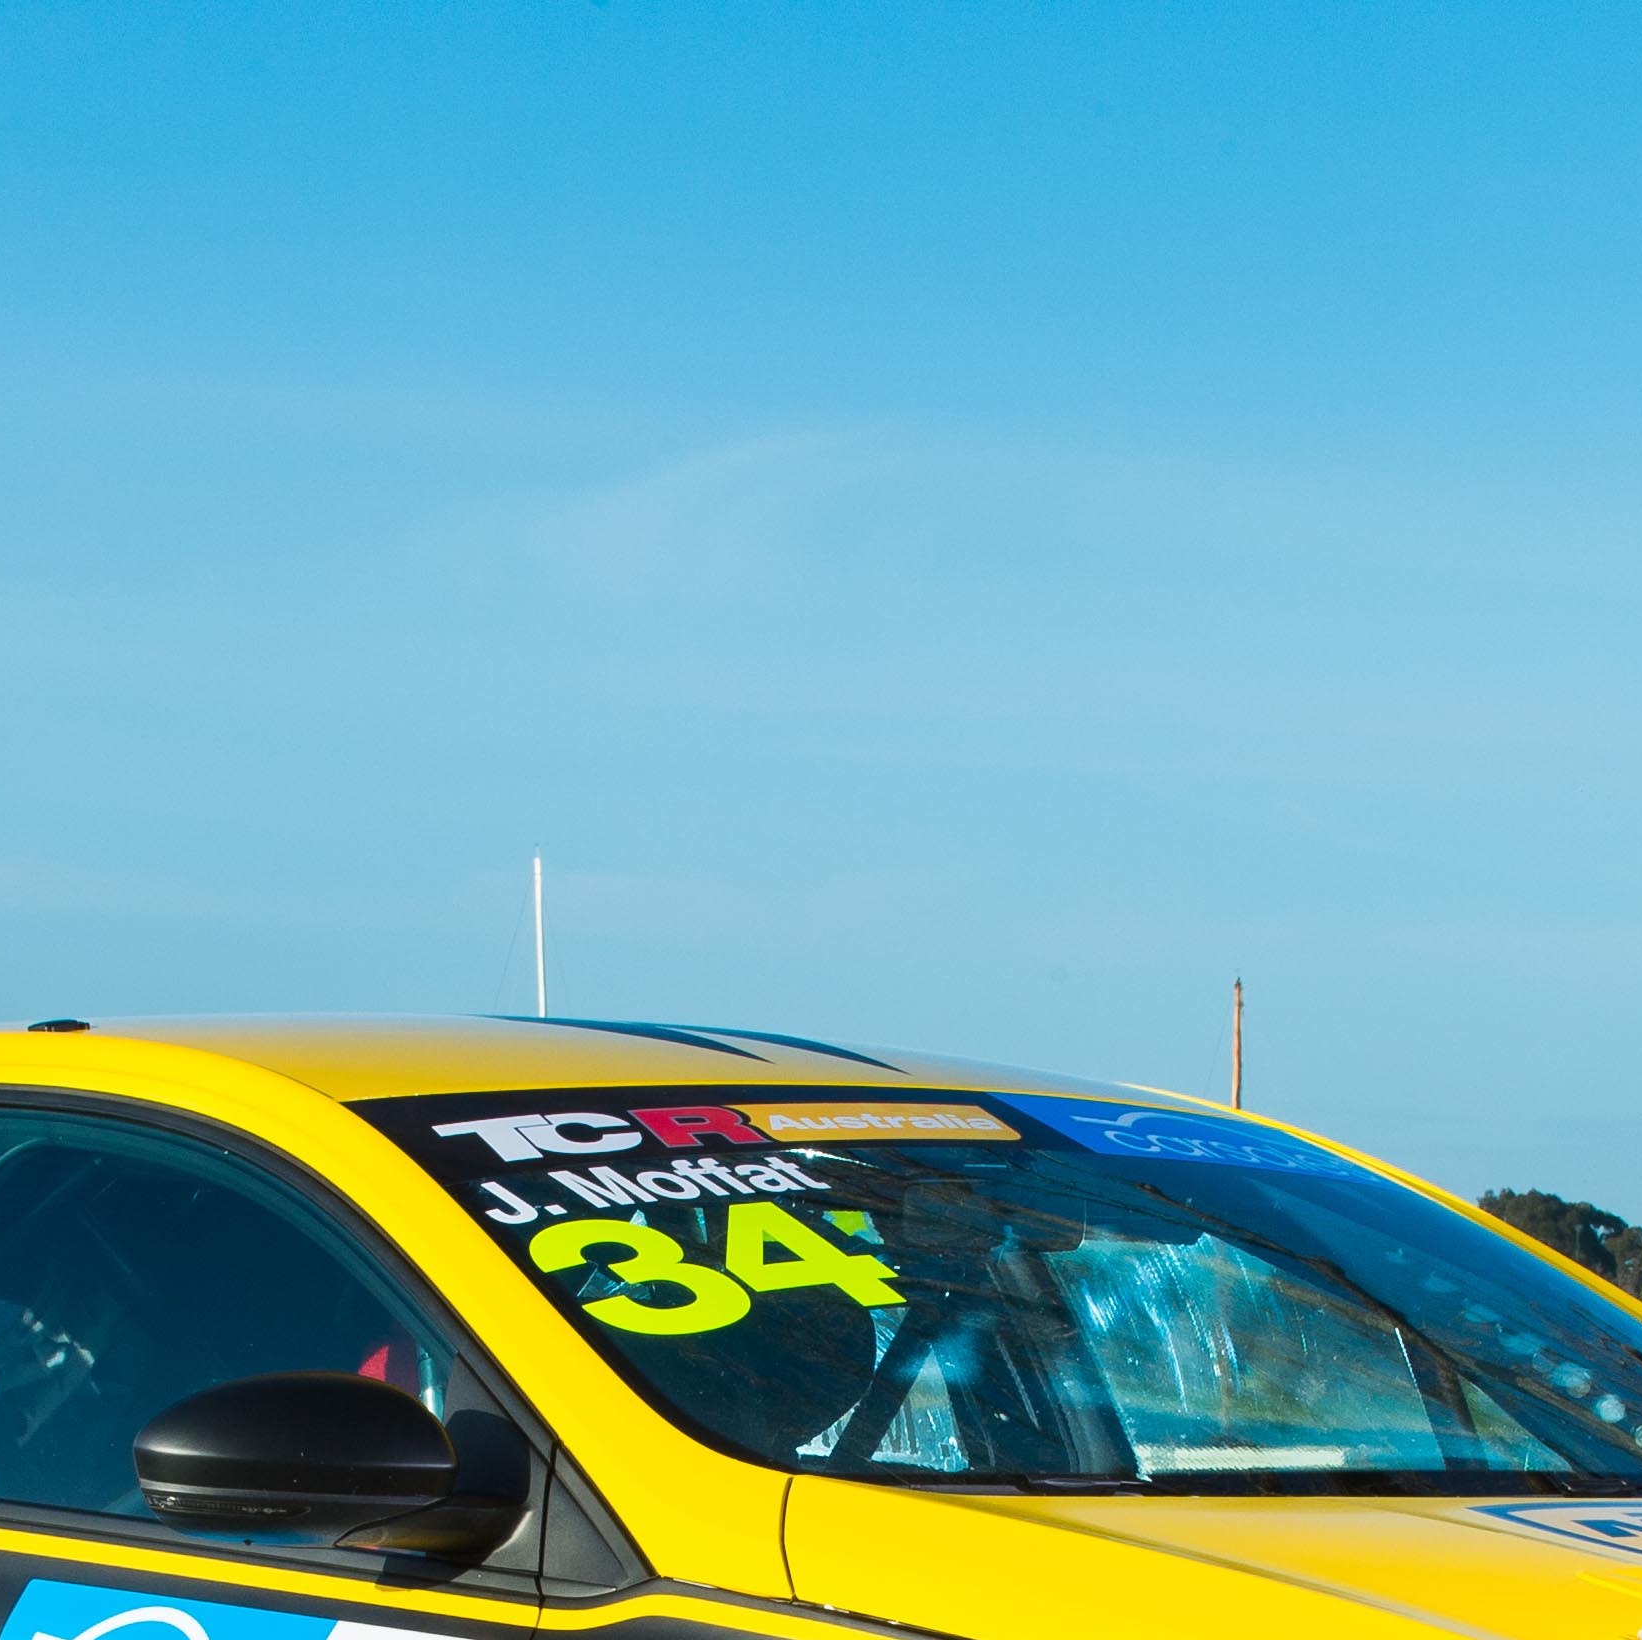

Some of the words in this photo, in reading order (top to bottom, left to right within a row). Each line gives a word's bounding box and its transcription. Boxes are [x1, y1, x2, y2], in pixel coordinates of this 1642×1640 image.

[431, 1103, 760, 1163] TCR
[767, 1104, 1002, 1136] Australia
[480, 1181, 557, 1226] J.
[564, 1153, 830, 1210] Moffat
[528, 1201, 908, 1337] 34
